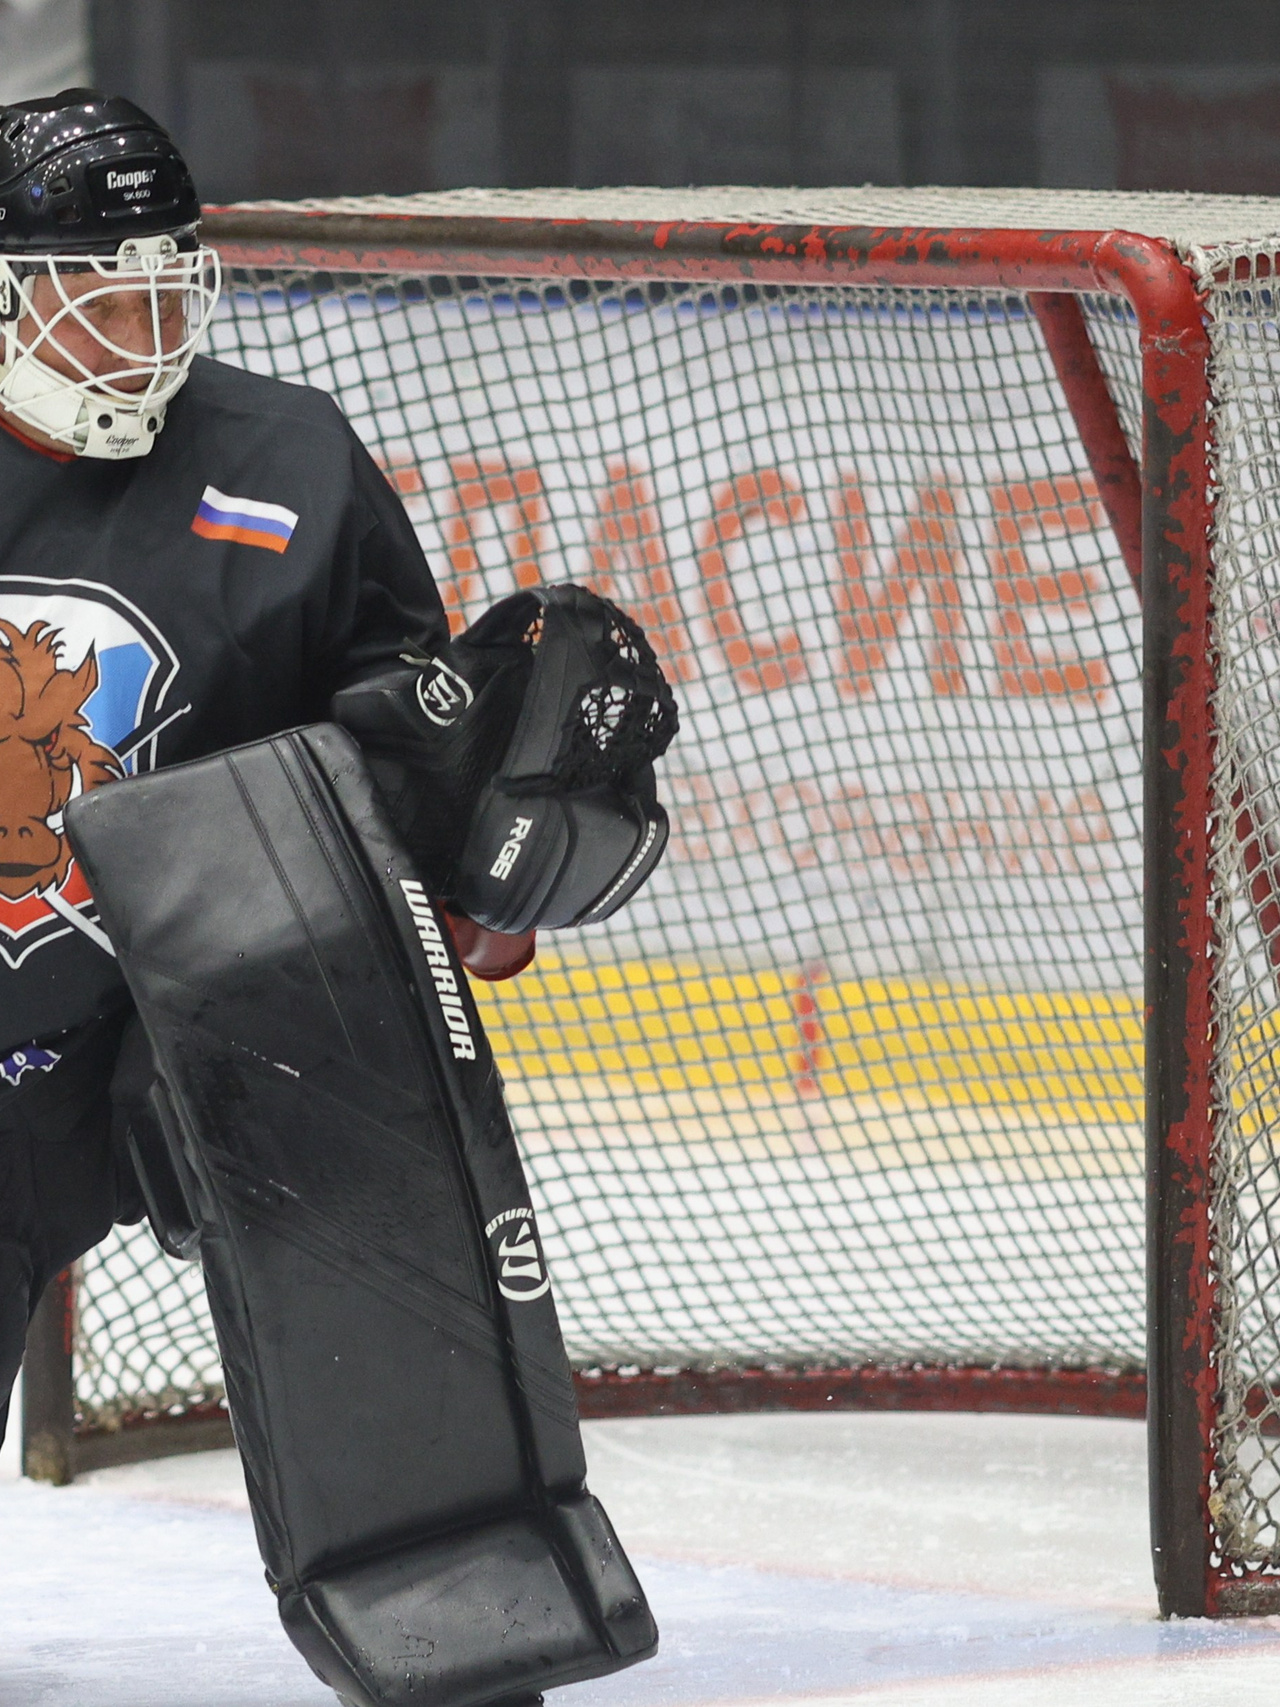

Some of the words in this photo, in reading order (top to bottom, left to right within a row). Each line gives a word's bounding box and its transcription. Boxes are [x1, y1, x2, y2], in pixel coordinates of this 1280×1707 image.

[107, 169, 156, 190] Cooper
[398, 878, 476, 1062] WARRIOR
[484, 1207, 535, 1239] RITUAL
